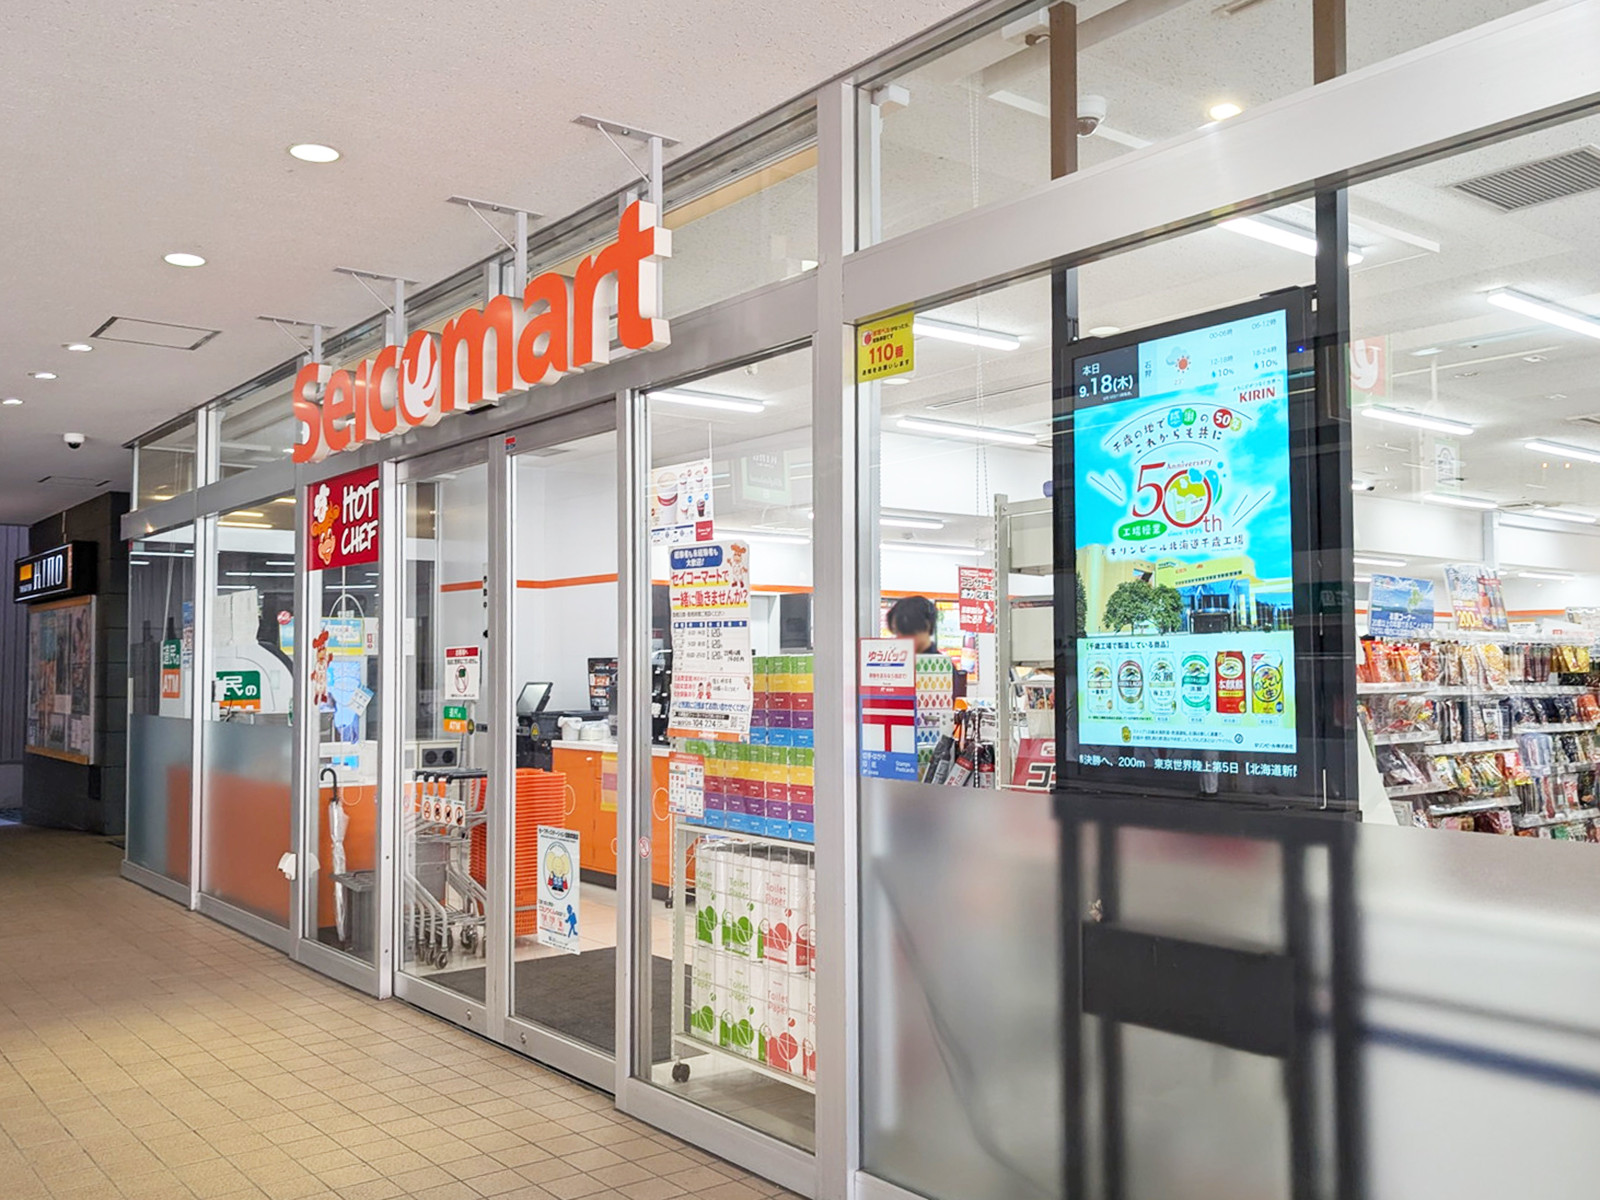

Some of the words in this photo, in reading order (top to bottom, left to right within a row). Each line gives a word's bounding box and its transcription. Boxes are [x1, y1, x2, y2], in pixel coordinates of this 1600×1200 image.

[869, 343, 903, 364] 110番
[1082, 362, 1100, 376] 本日
[1239, 386, 1276, 403] KIRIN
[342, 479, 379, 524] HOT
[341, 520, 379, 556] CHEF
[671, 568, 729, 587] セイコーマートで
[765, 881, 787, 896] Toilet
